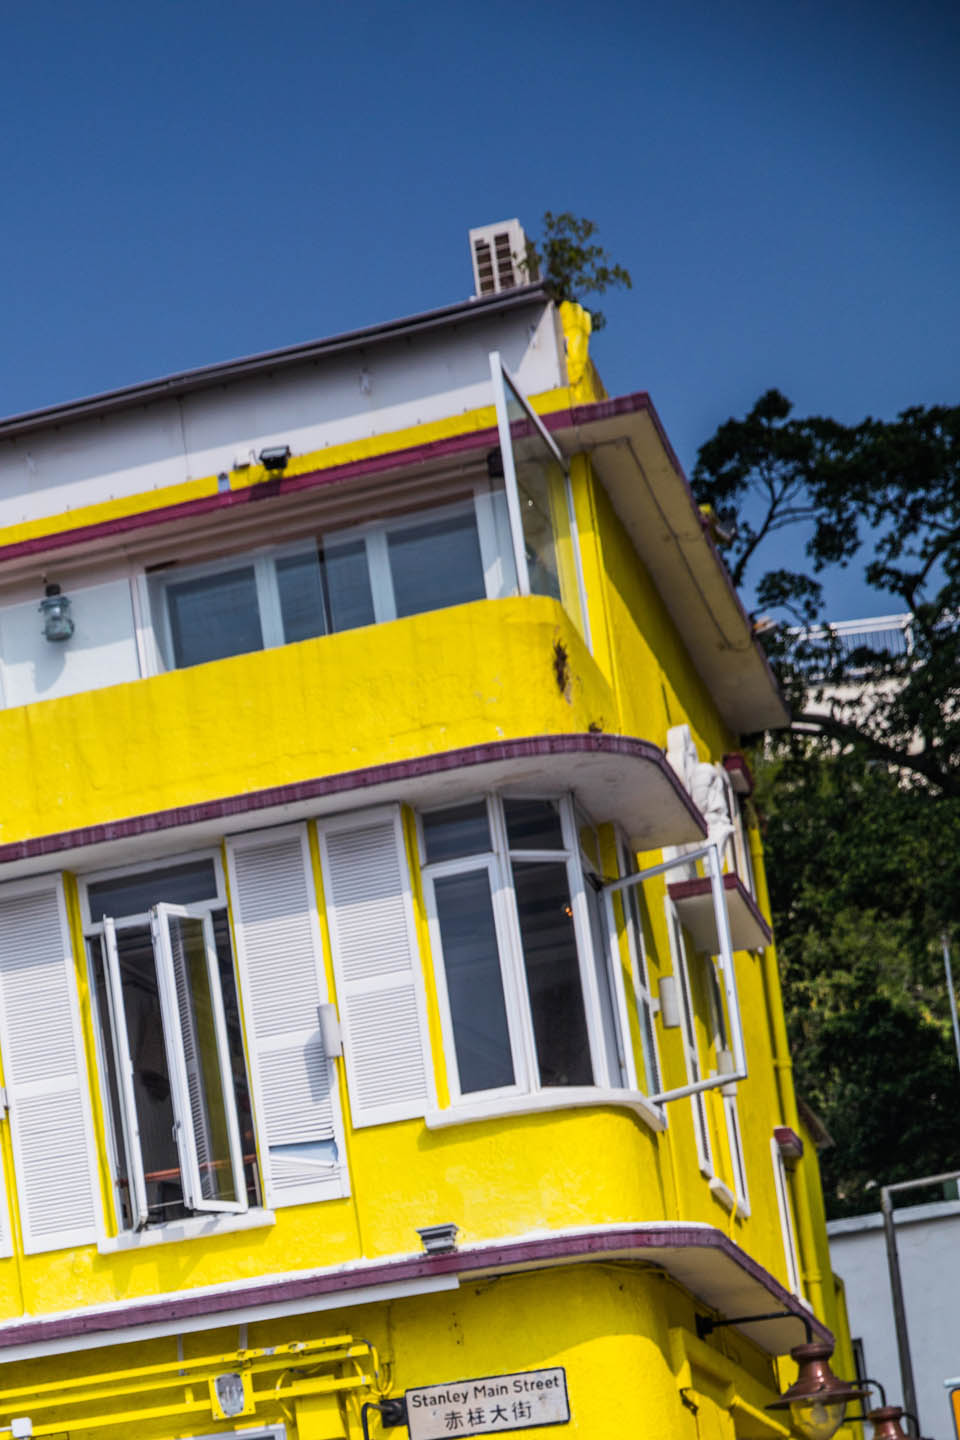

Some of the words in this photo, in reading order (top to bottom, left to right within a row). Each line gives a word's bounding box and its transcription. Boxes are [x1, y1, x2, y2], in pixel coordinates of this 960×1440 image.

[412, 1390, 469, 1408] Stanley
[473, 1385, 509, 1400] Main
[513, 1375, 560, 1394] Street
[444, 1400, 533, 1431] 赤柱大街
